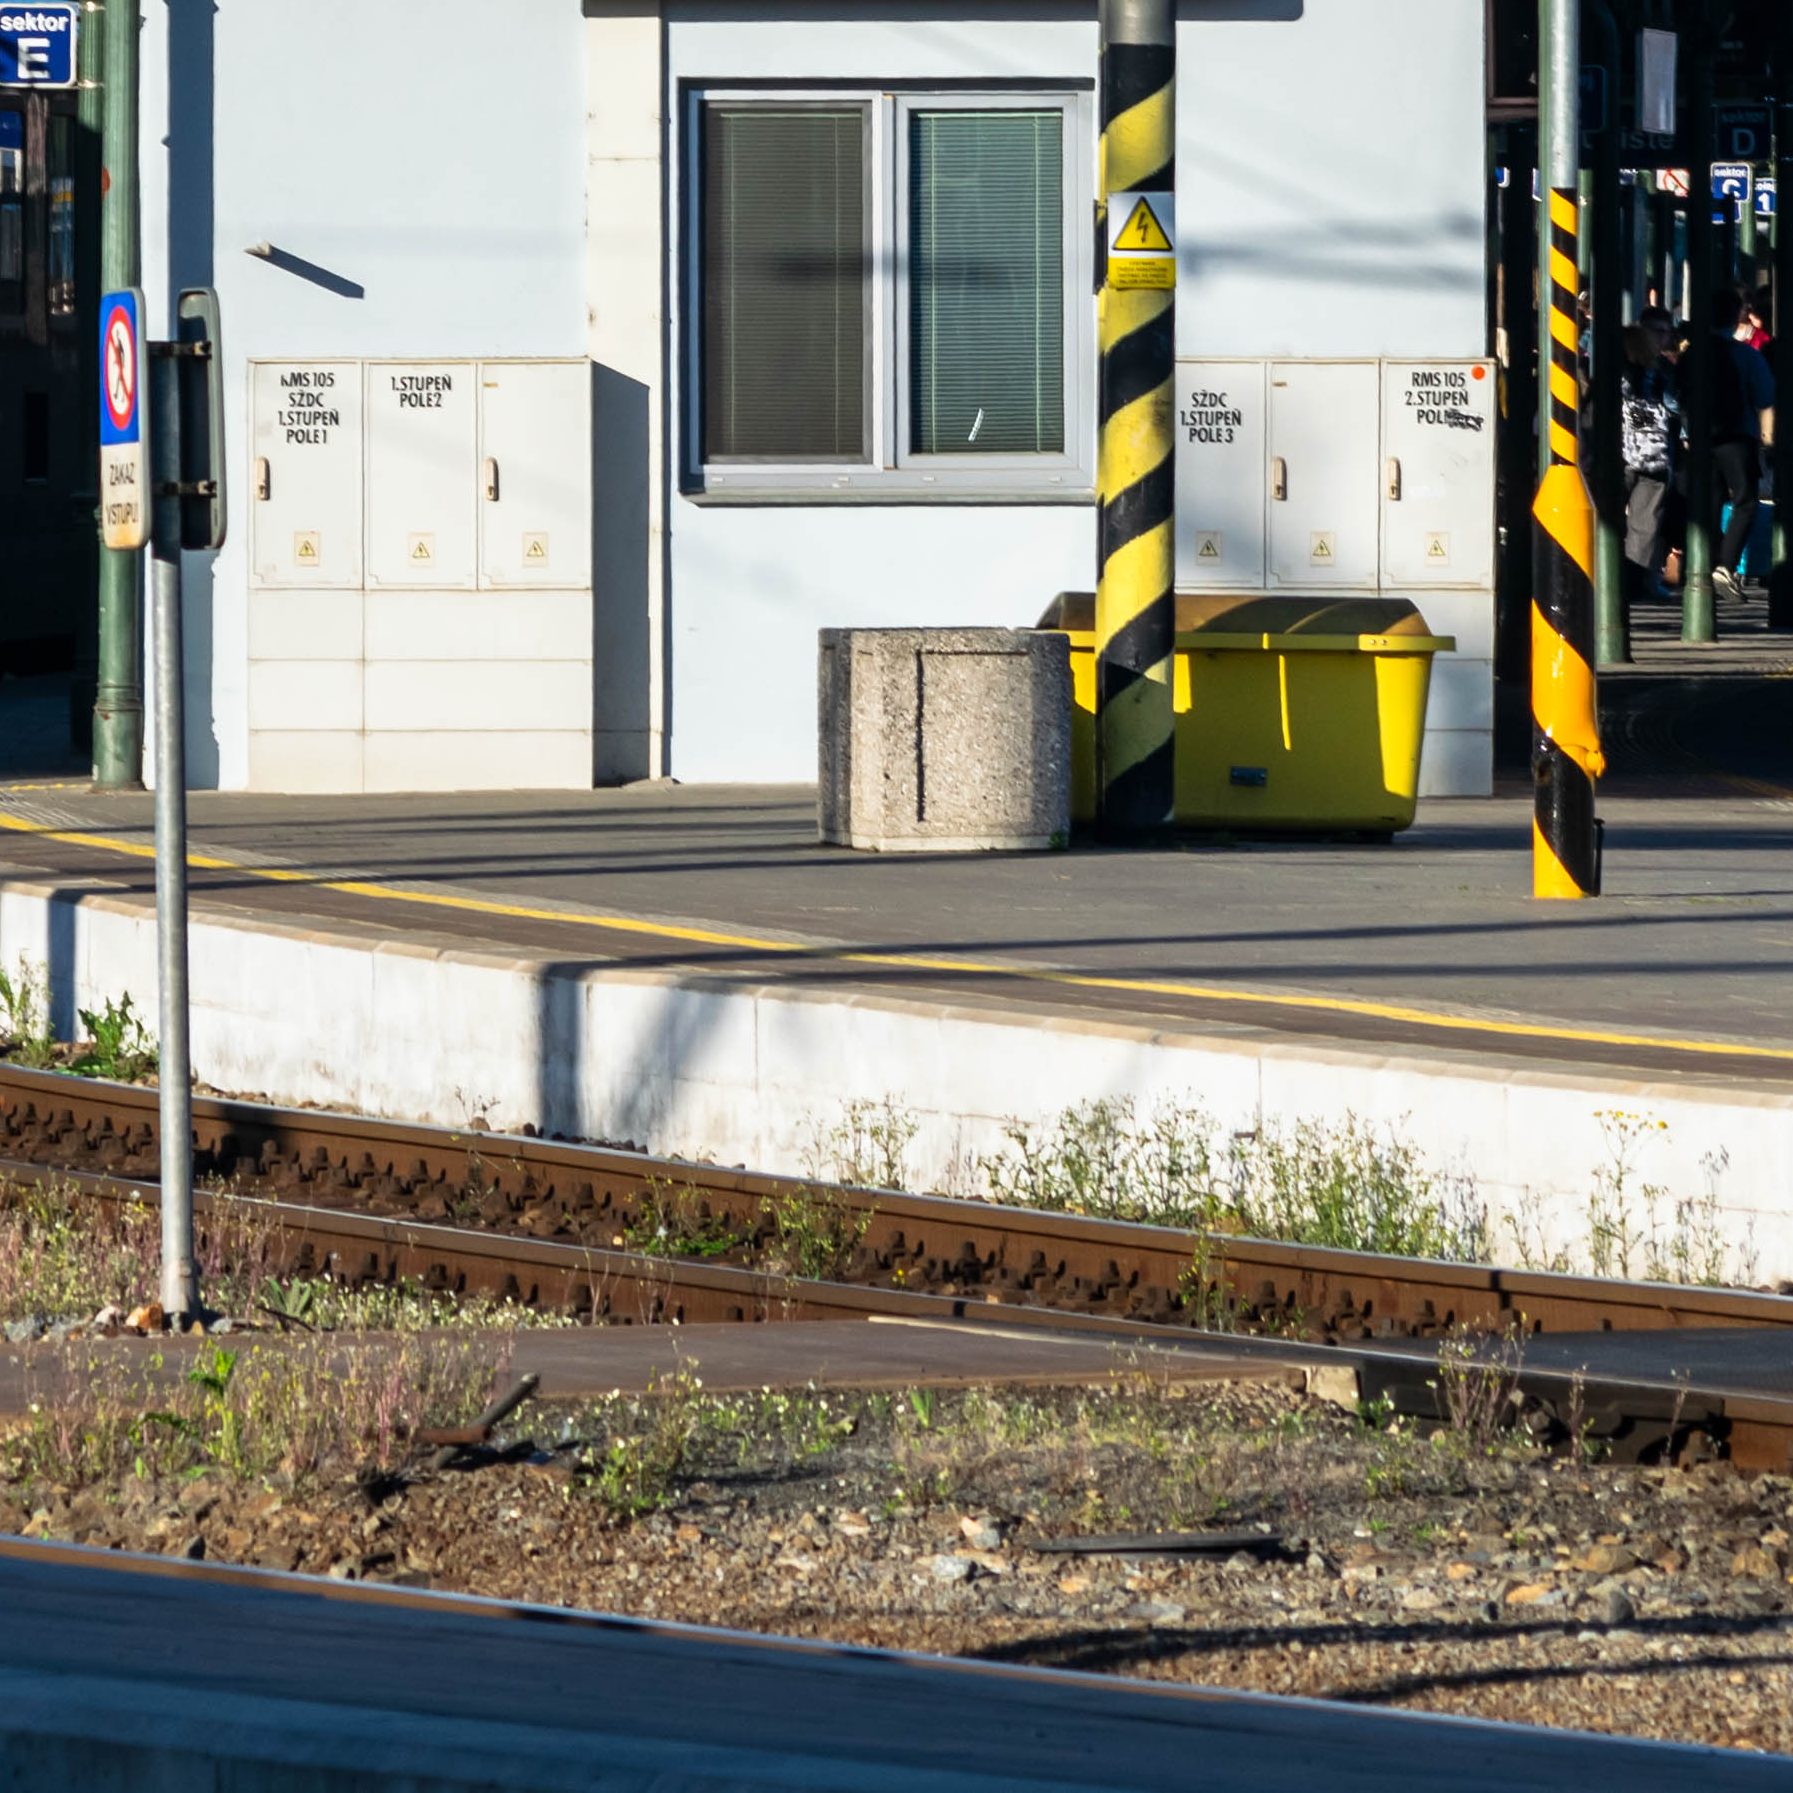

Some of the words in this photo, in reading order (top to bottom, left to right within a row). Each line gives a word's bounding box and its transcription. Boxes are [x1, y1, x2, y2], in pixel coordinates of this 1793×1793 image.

[0, 12, 69, 32] sektor
[16, 37, 51, 80] E
[1732, 127, 1756, 157] D
[1757, 191, 1772, 212] 1
[312, 372, 335, 387] 105
[1411, 372, 1442, 387] RMS
[1443, 372, 1466, 387] 105
[288, 389, 325, 407] SŽDC
[399, 392, 432, 408] POLE
[432, 392, 443, 408] 2
[1191, 389, 1229, 407] SŽDC
[286, 428, 320, 444] POLE
[321, 428, 328, 444] 1
[1188, 427, 1223, 443] POLE
[1224, 427, 1234, 443] 3
